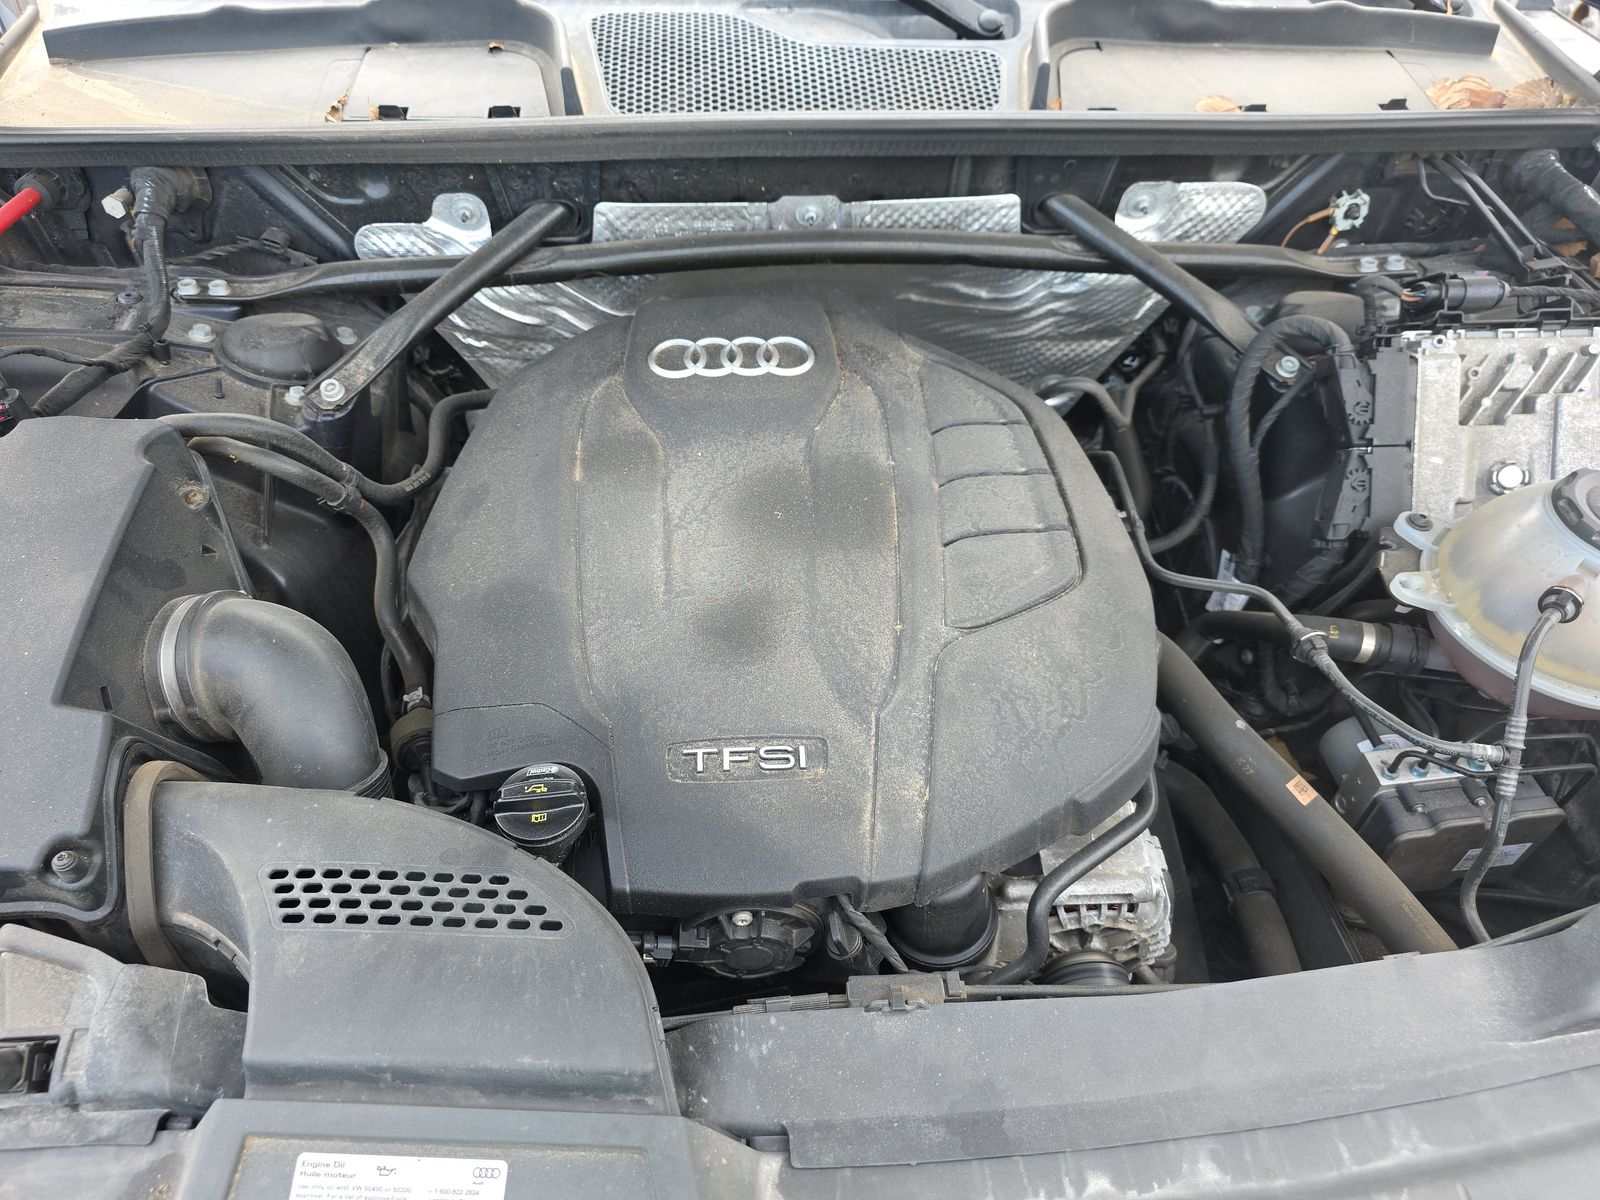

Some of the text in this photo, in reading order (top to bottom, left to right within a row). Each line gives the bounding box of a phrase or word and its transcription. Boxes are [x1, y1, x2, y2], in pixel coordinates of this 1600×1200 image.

[682, 745, 807, 773] TFSI
[301, 1160, 345, 1169] Engine Oil
[299, 1170, 321, 1178] Huile
